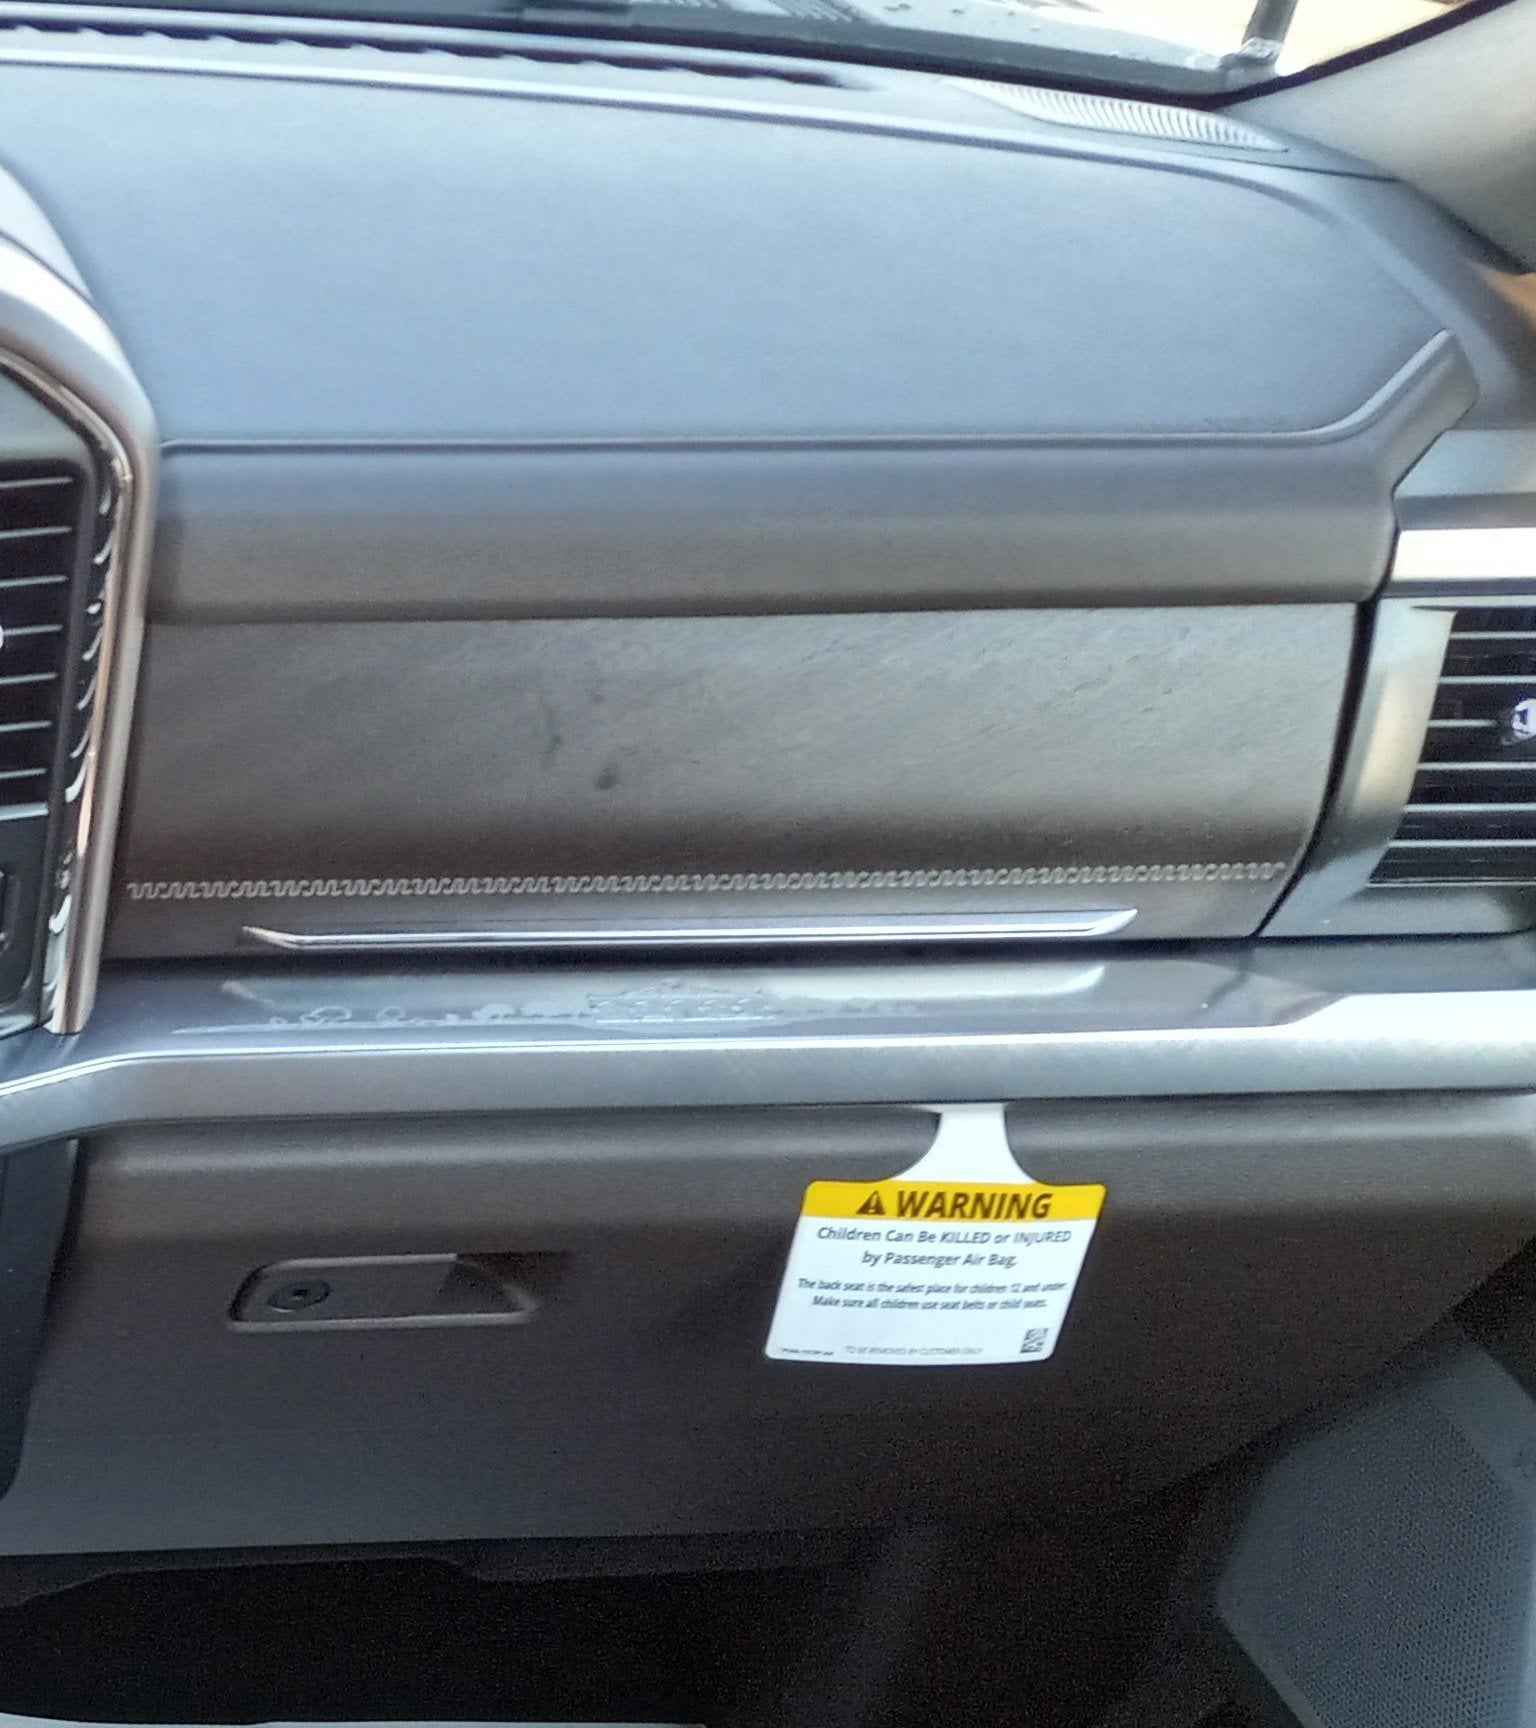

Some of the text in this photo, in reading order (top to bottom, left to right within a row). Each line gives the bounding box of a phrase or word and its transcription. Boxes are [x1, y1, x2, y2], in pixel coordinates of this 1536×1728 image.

[896, 1190, 1053, 1220] WARNING
[817, 1227, 1072, 1246] Children Can Be KILLED or INJURED
[862, 1250, 881, 1267] by
[884, 1251, 960, 1268] Passenger
[962, 1253, 985, 1266] Air
